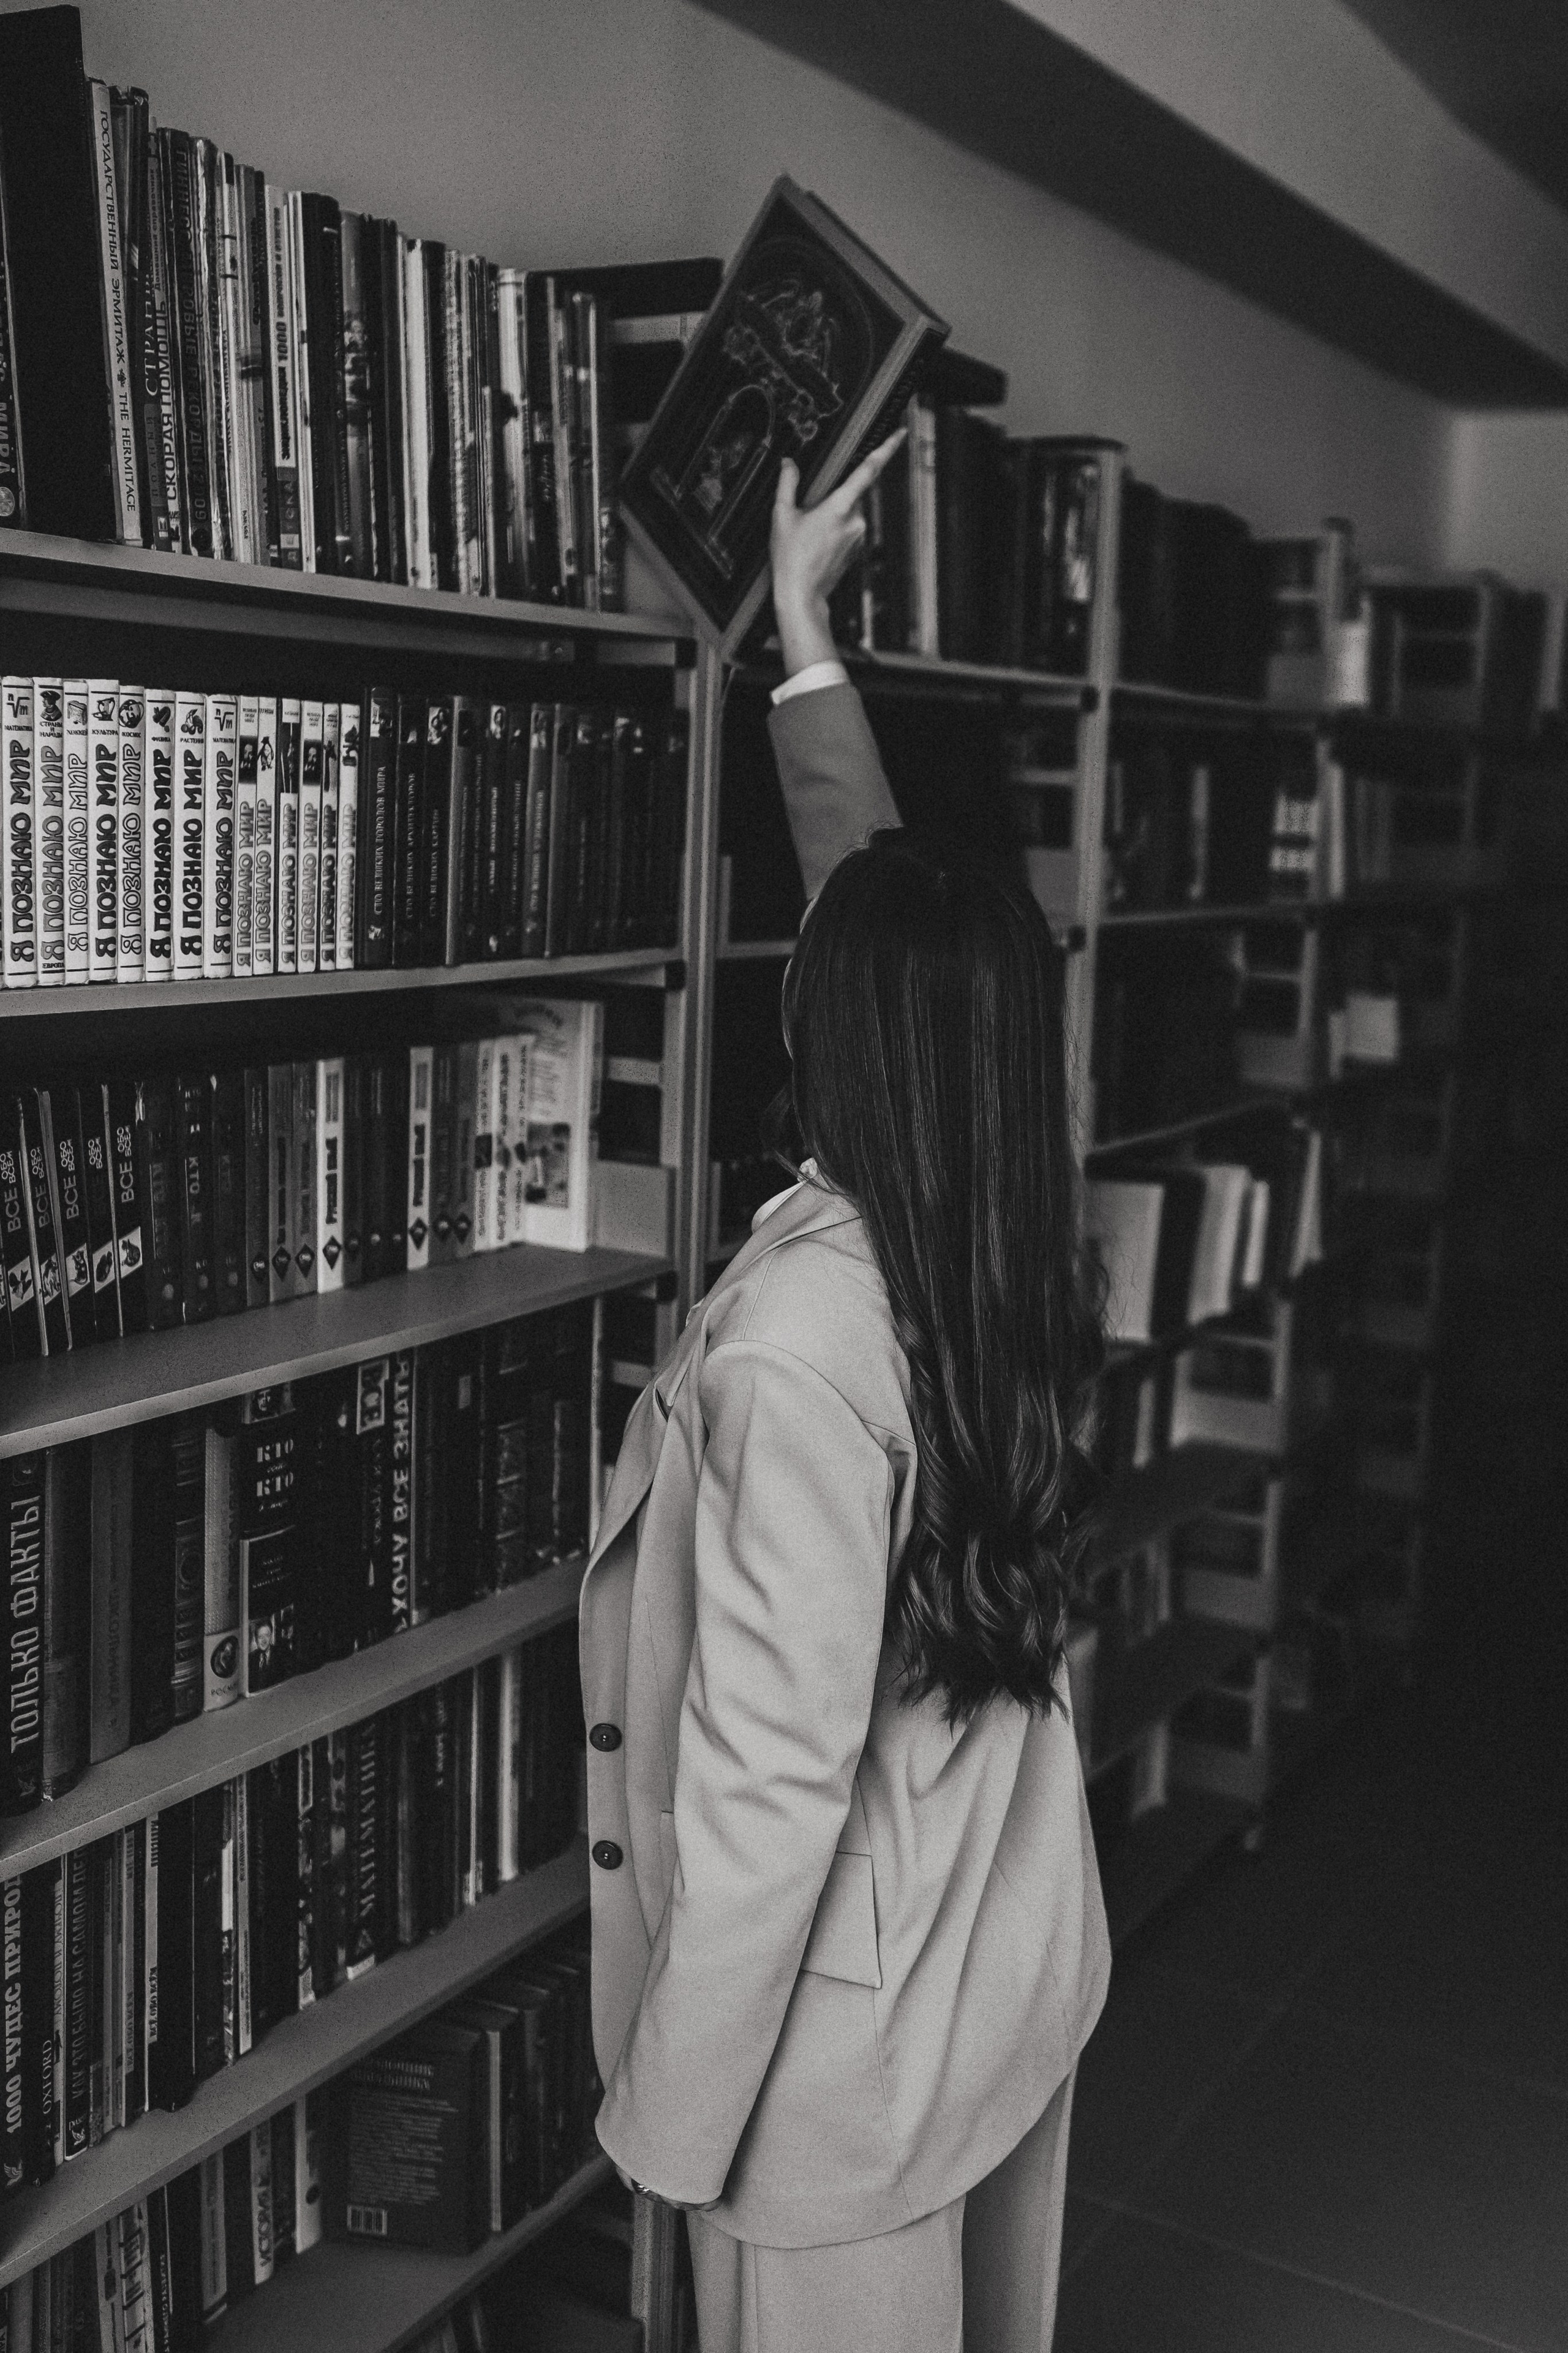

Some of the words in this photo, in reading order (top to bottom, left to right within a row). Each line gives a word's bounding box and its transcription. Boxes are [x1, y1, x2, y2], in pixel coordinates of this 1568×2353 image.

[100, 110, 119, 271] ГОСУДАРСТВЕННЫЙ
[111, 278, 126, 364] ЭРМИТАЖ
[176, 150, 191, 243] ГИННЕСС
[187, 367, 205, 463] РЕКОРДЫ
[154, 300, 172, 406] ПОМОЩЬ
[276, 321, 288, 363] 1000
[118, 392, 130, 421] THE
[121, 428, 136, 513] HERMITAGE
[160, 412, 177, 501] СКОРАЯ
[10, 739, 31, 806] МИР
[41, 745, 64, 807] МИР
[69, 753, 88, 810] МИР
[96, 743, 116, 807] МИР
[122, 743, 141, 806] МИР
[153, 749, 172, 810] МИР
[184, 749, 203, 810] МИР
[216, 750, 233, 810] МИР
[238, 801, 254, 849] МИР
[255, 799, 271, 848] МИР
[283, 804, 296, 849] МИР
[304, 803, 318, 849] МИР
[322, 804, 336, 849] МИР
[10, 812, 33, 934] ПОЗНАЮ
[42, 815, 64, 933] ПОЗНАЮ
[69, 817, 88, 926] ПОЗНАЮ
[96, 814, 117, 930] ПОЗНАЮ
[122, 812, 141, 928] ПОЗНАЮ
[152, 818, 172, 932] ПОЗНАЮ
[182, 818, 203, 929] ПОЗНАЮ
[216, 818, 233, 928] ПОЗНАЮ
[237, 853, 253, 947] ПОЗНАЮ
[255, 850, 271, 944] ПОЗНАЮ
[281, 854, 296, 945] ПОЗНАЮ
[301, 854, 317, 944] ПОЗНАЮ
[322, 854, 337, 945] ПОЗНАЮ
[10, 940, 34, 962] Я
[40, 939, 64, 961] Я
[67, 932, 88, 951] Я
[95, 935, 116, 957] Я
[120, 934, 142, 955] Я
[149, 938, 172, 958] Я
[180, 935, 203, 956] Я
[213, 934, 233, 955] Я
[236, 953, 251, 968] Я
[255, 950, 271, 964] Я
[282, 950, 296, 964] Я
[300, 949, 317, 964] Я
[321, 950, 336, 964] Я
[30, 1148, 39, 1176] ОБО
[59, 1141, 68, 1168] ОБО
[67, 1138, 75, 1172] ВСЕМ
[88, 1139, 96, 1166] ОБО
[116, 1126, 125, 1153] ОБО
[7, 1150, 17, 1184] ВСЕМ
[119, 1160, 135, 1203] ВСЕ
[187, 1155, 201, 1195] КТО
[3, 1187, 21, 1233] ВСЕ
[35, 1183, 50, 1228] ВСЕ
[62, 1174, 80, 1220] ВСЕ
[392, 1351, 410, 1460] ЗНАТЬ
[256, 1437, 295, 1464] КТО
[256, 1471, 295, 1498] КТО
[392, 1467, 409, 1524] ВСЕ
[10, 1494, 41, 1619] ФАКТЫ
[391, 1533, 409, 1616] ХОЧУ
[10, 1625, 40, 1755] ТОЛЬКО
[359, 1722, 376, 1917] МАТЕМАТИКА
[71, 1885, 87, 1957] САМОМ
[70, 1957, 86, 1984] НА
[5, 1982, 24, 2073] ЧУДЕС
[71, 1985, 86, 2036] БЫЛО
[71, 2035, 86, 2067] ЭТО
[42, 2039, 53, 2115] OXFORD
[70, 2070, 86, 2099] КАК
[5, 2074, 23, 2133] 1000
